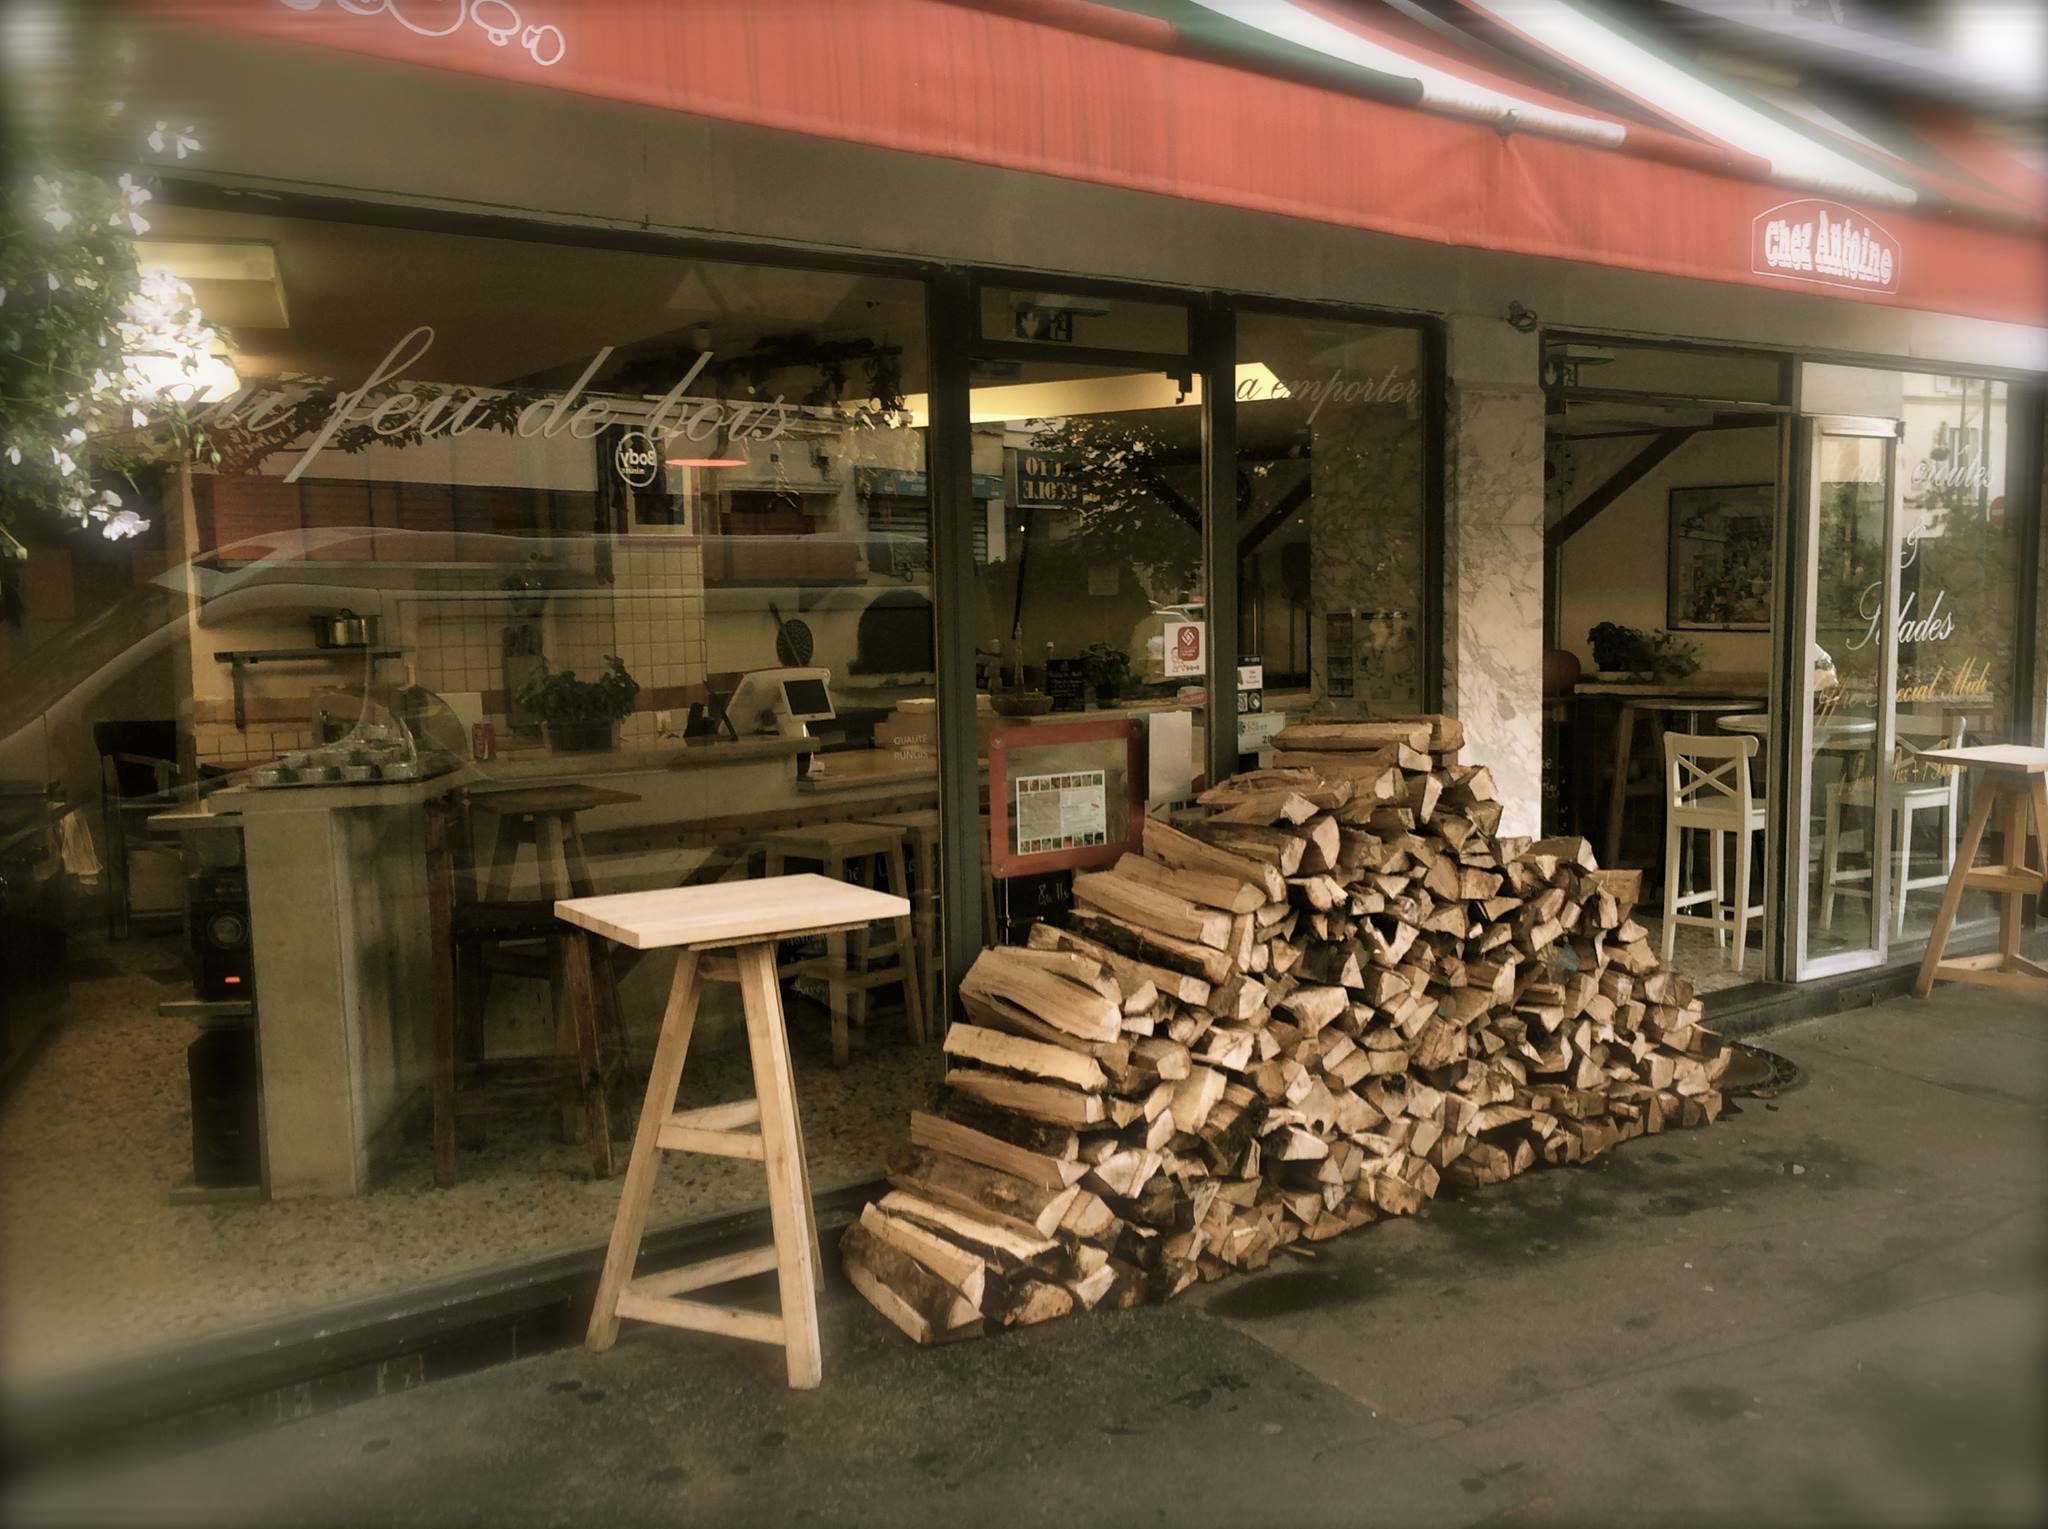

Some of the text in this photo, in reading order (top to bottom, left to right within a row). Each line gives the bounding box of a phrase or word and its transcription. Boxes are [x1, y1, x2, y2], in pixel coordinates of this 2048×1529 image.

[1764, 209, 1894, 286] Chez Antoine
[282, 325, 489, 483] feu
[516, 346, 620, 440] de
[644, 350, 798, 442] bois
[1270, 364, 1420, 425] emporter
[1845, 581, 1955, 651] Slades
